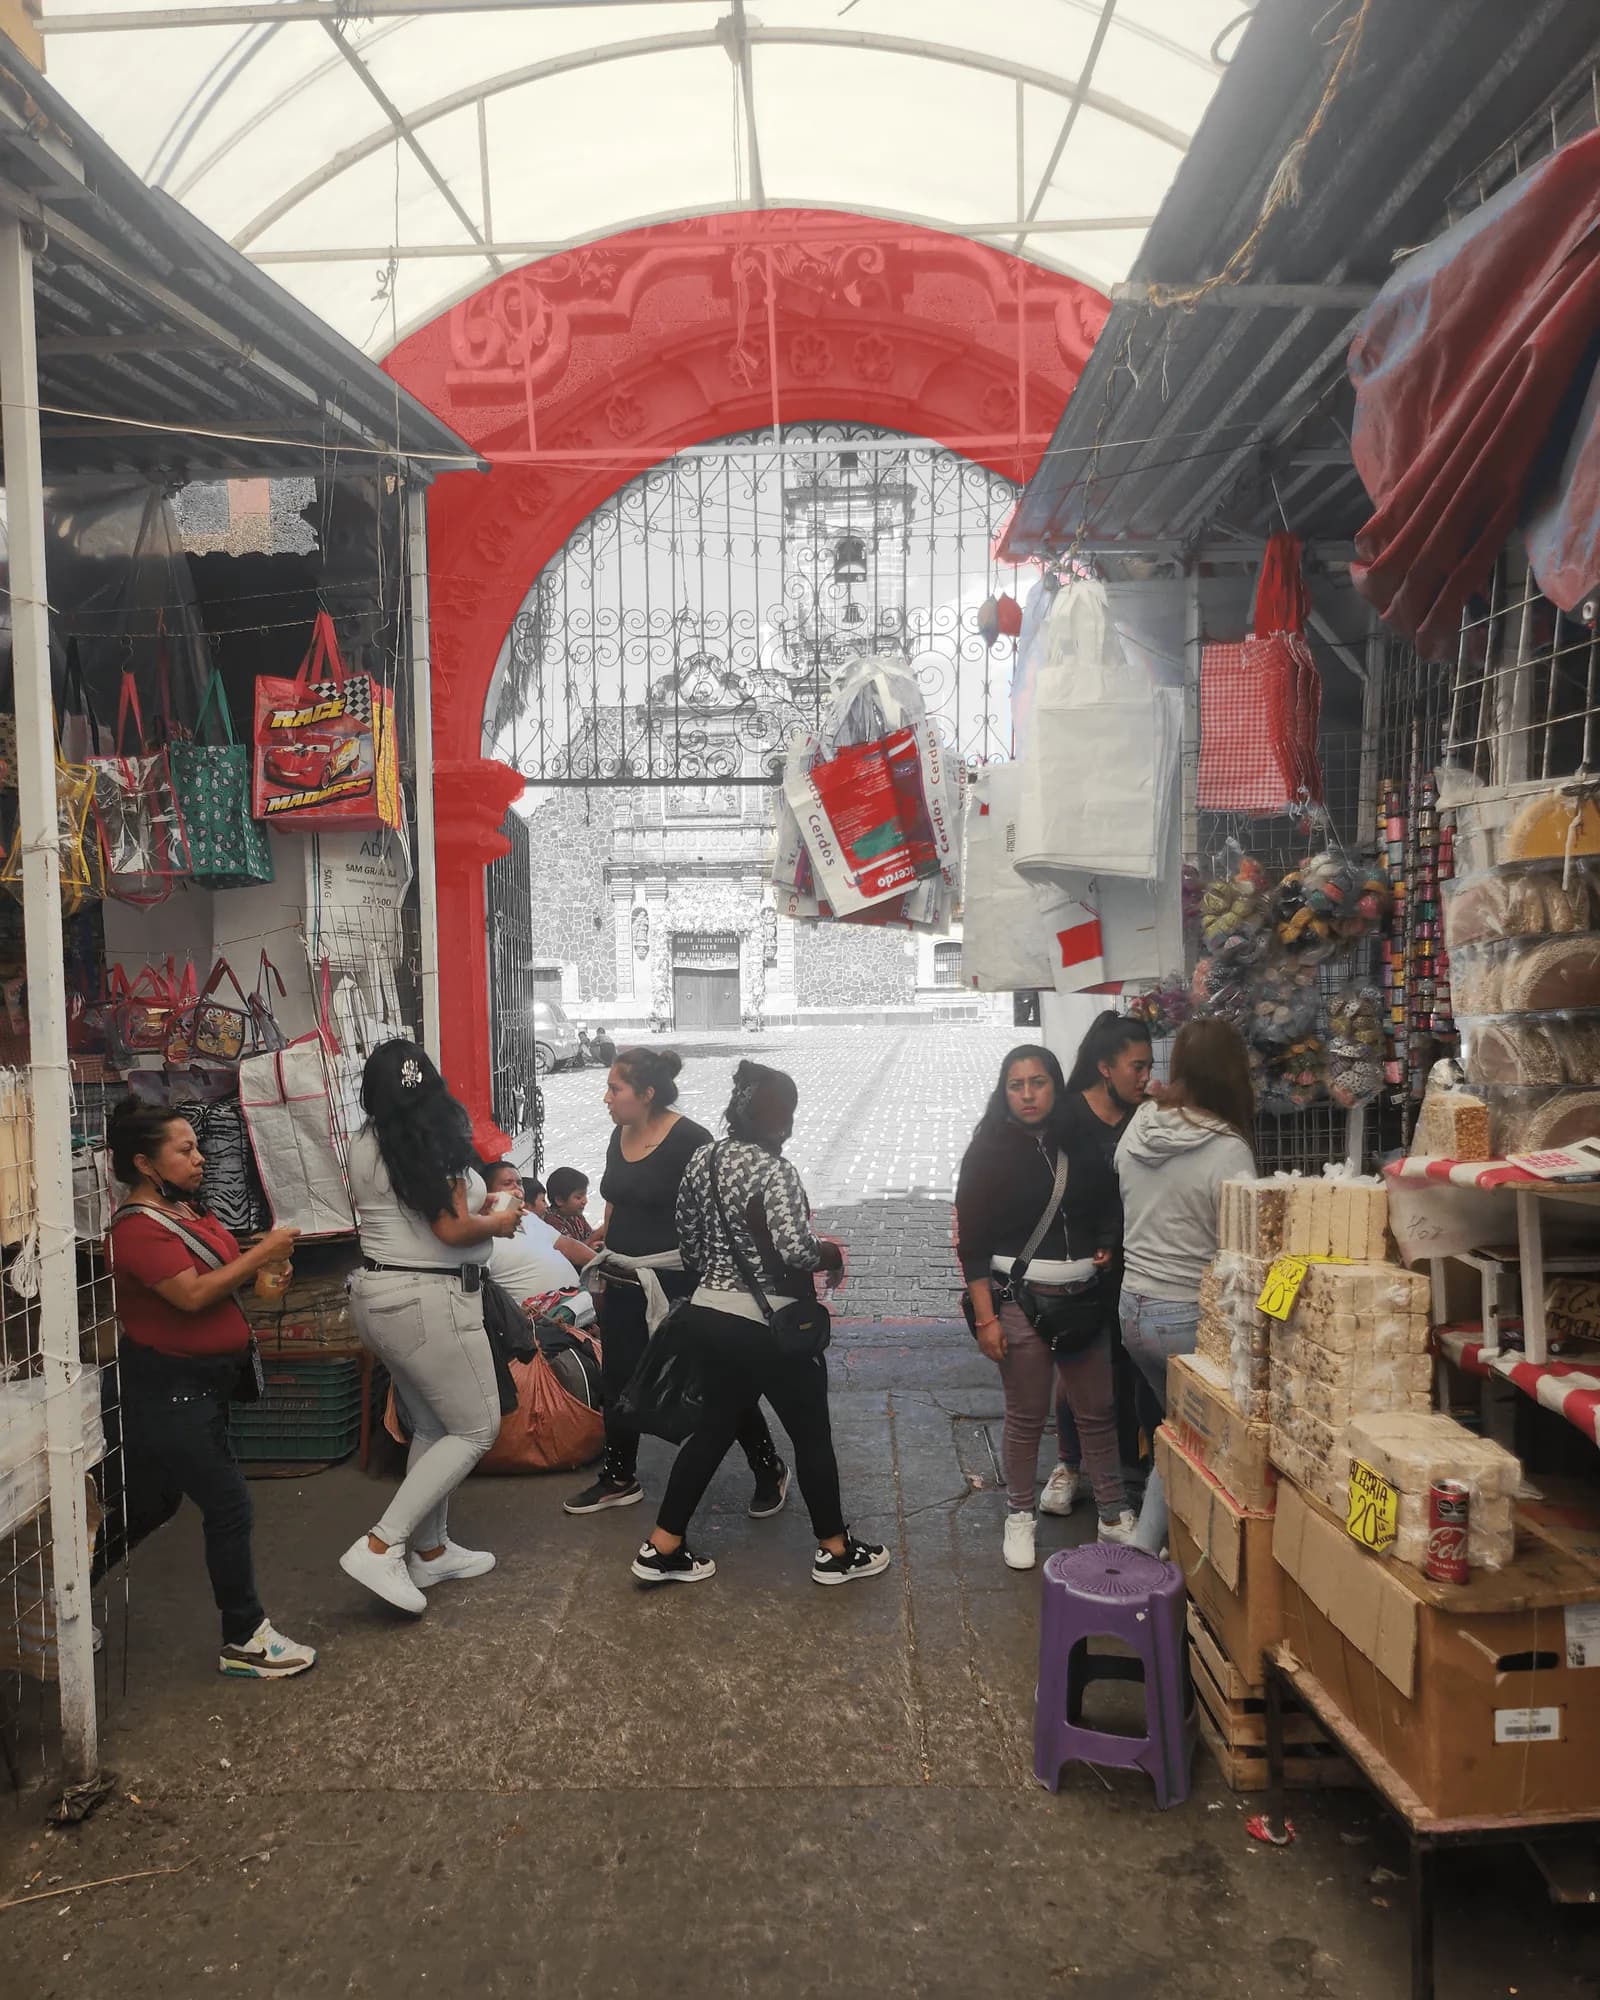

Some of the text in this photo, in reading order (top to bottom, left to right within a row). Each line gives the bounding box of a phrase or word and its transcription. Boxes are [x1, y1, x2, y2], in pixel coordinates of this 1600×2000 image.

[269, 696, 347, 729] RACE
[926, 730, 941, 785] Cerdos
[265, 778, 372, 814] MADNESS
[808, 814, 836, 867] Cerdos
[931, 799, 950, 854] Cerdos
[323, 868, 334, 891] SAM
[344, 863, 363, 873] SAM
[1348, 1461, 1388, 1508] ALEGRIA
